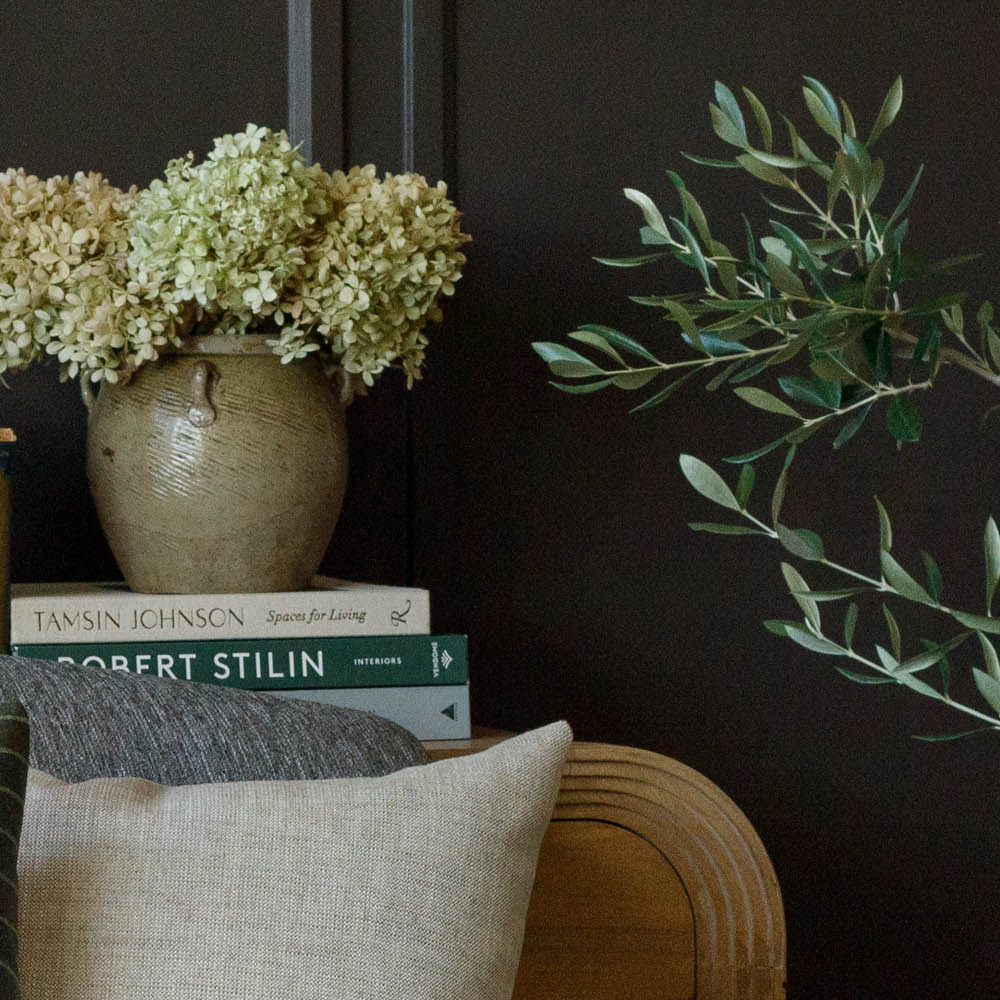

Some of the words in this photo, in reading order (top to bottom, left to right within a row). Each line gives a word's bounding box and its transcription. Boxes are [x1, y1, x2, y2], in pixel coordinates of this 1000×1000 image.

[33, 610, 120, 632] TAMSIN
[131, 607, 244, 630] JOHNSON
[266, 609, 306, 626] Spaces
[308, 608, 327, 625] for
[328, 607, 368, 625] Living
[213, 650, 325, 680] STILIN
[353, 657, 403, 666] INTERIORS
[431, 642, 440, 678] VENDOME
